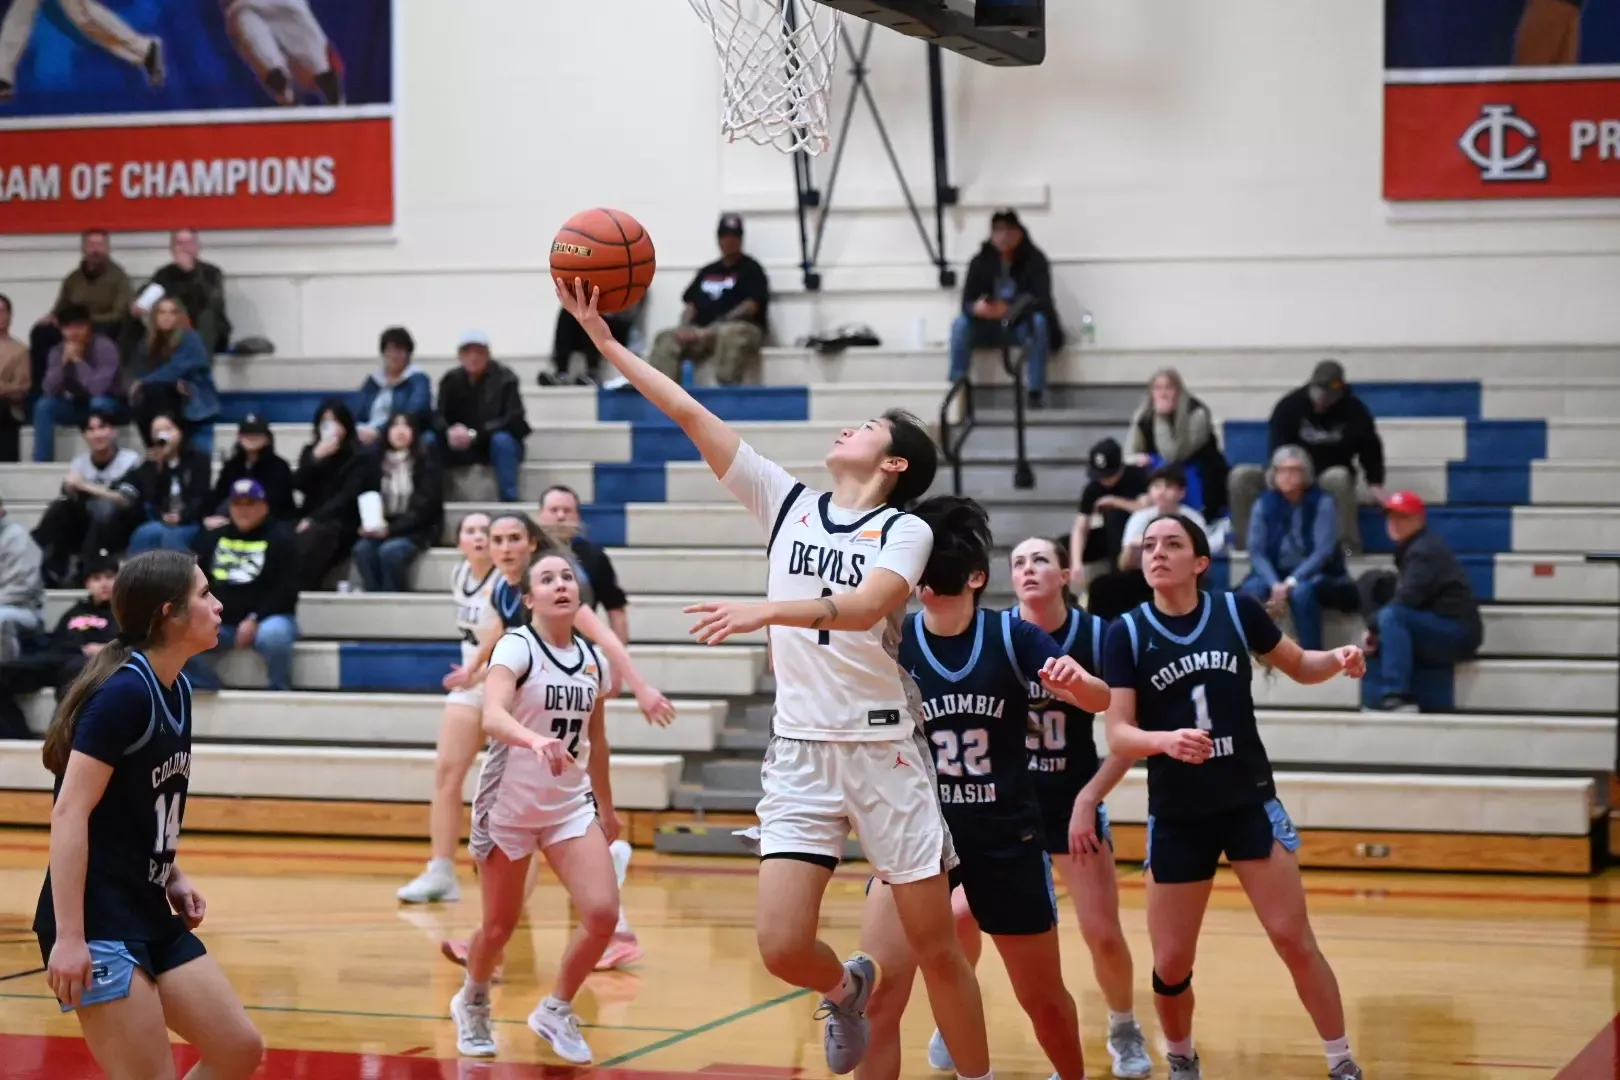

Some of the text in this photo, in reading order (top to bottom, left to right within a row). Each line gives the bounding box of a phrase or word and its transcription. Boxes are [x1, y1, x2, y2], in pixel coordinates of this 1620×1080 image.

[70, 163, 113, 199] OF
[121, 156, 336, 198] CHAMPIONS
[788, 540, 865, 588] DEVILS
[1151, 650, 1238, 691] COLUMBIA
[544, 684, 594, 713] DEVILS
[922, 693, 1005, 722] OLUMBIA
[1191, 684, 1213, 731] 1
[931, 728, 991, 777] 22
[1027, 754, 1068, 772] ASIN
[940, 782, 996, 804] BASIN
[155, 792, 181, 853] 14
